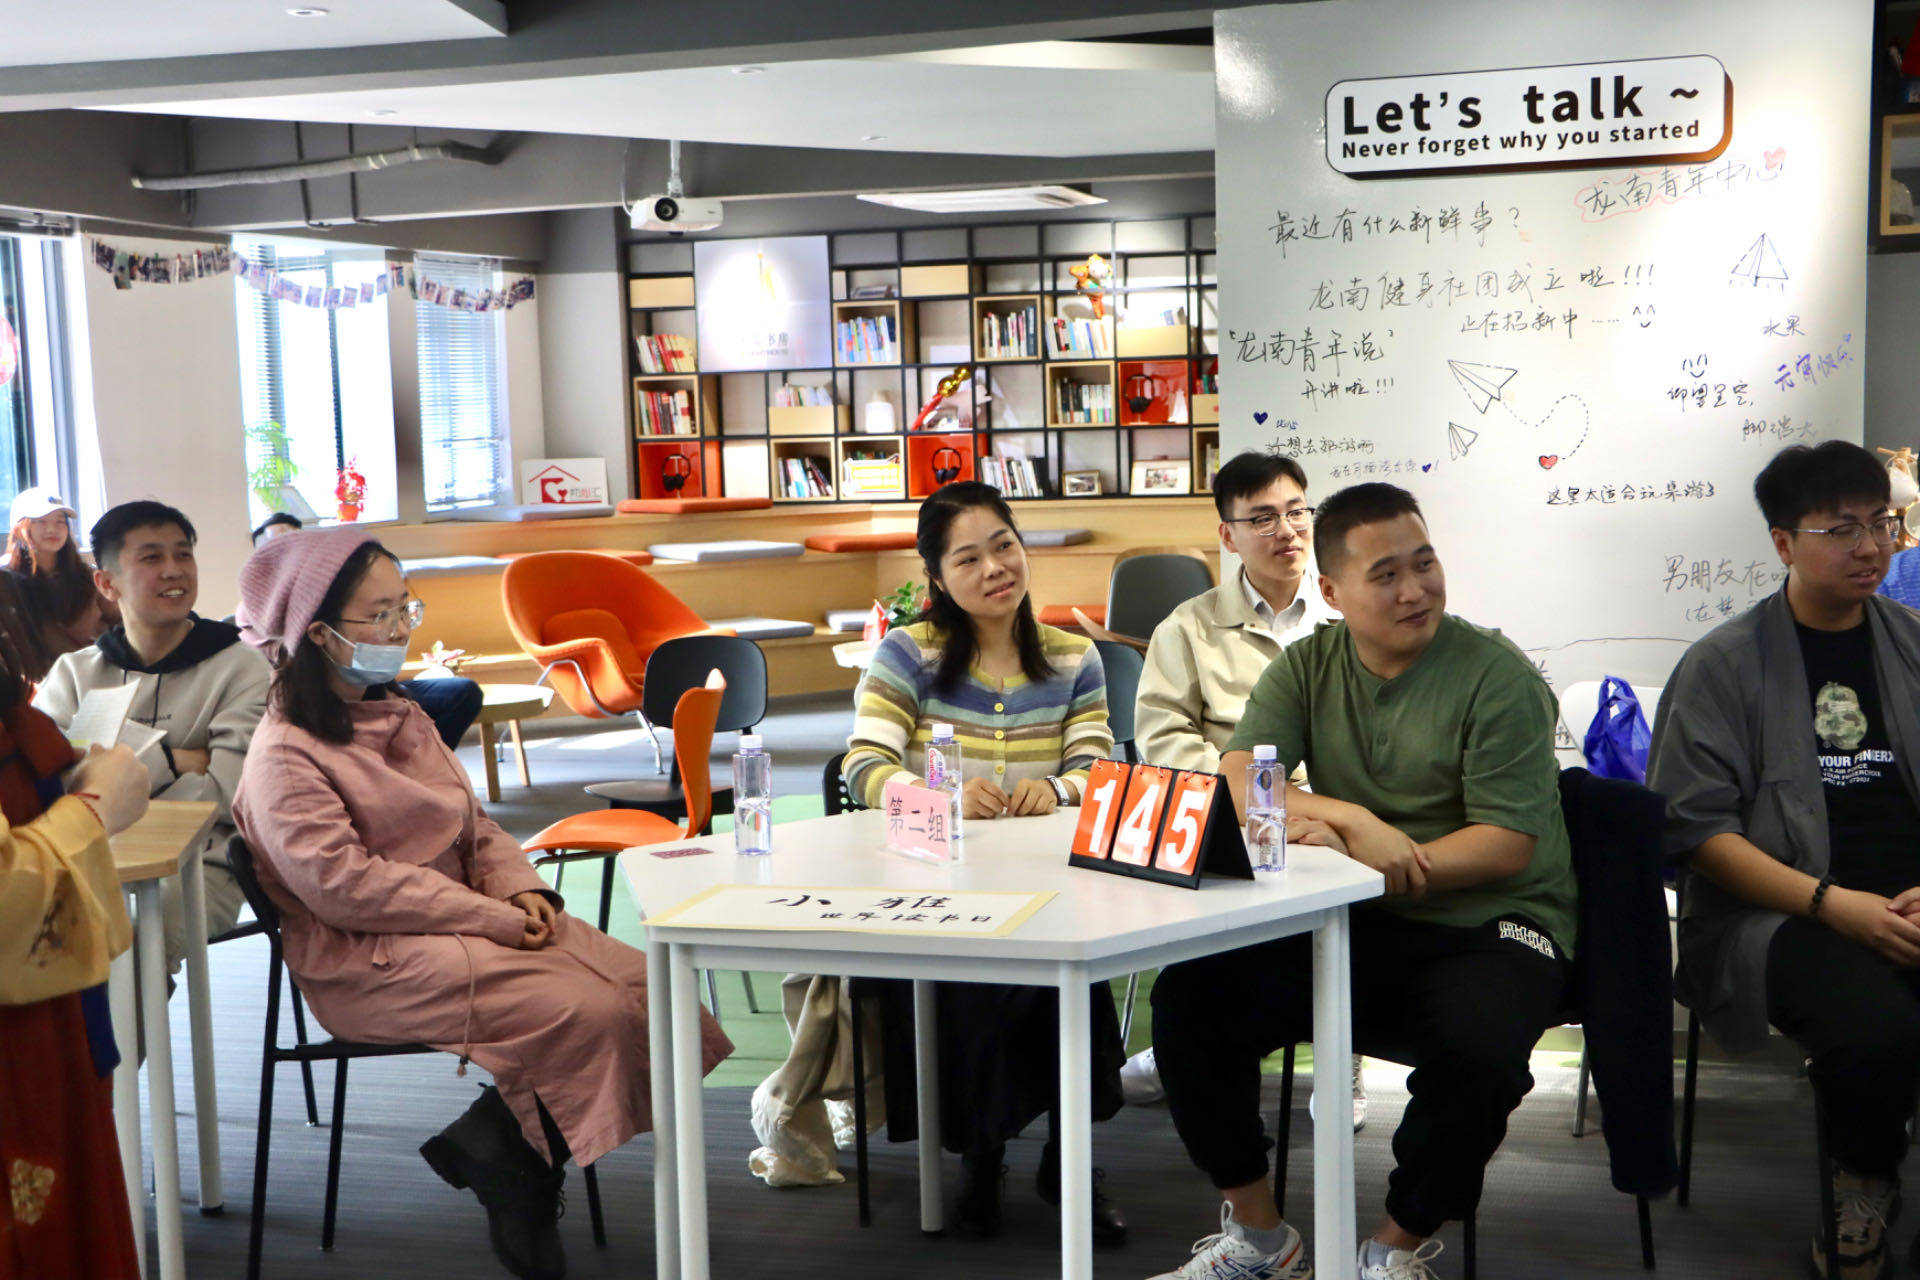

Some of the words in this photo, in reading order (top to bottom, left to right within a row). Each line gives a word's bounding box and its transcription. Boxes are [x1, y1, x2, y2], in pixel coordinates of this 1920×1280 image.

[1344, 92, 1482, 135] Let’s
[1523, 75, 1643, 124] talk
[1343, 141, 1409, 158] Never
[1418, 135, 1490, 156] forget
[1500, 130, 1547, 151] why
[1558, 131, 1599, 149] you
[1610, 120, 1699, 142] started
[1584, 159, 1783, 215] 龙南青年中心
[1762, 315, 1806, 336] 水果
[1818, 755, 1852, 767] YOUR
[890, 796, 946, 843] 第二组
[819, 911, 993, 924] 世界读书日
